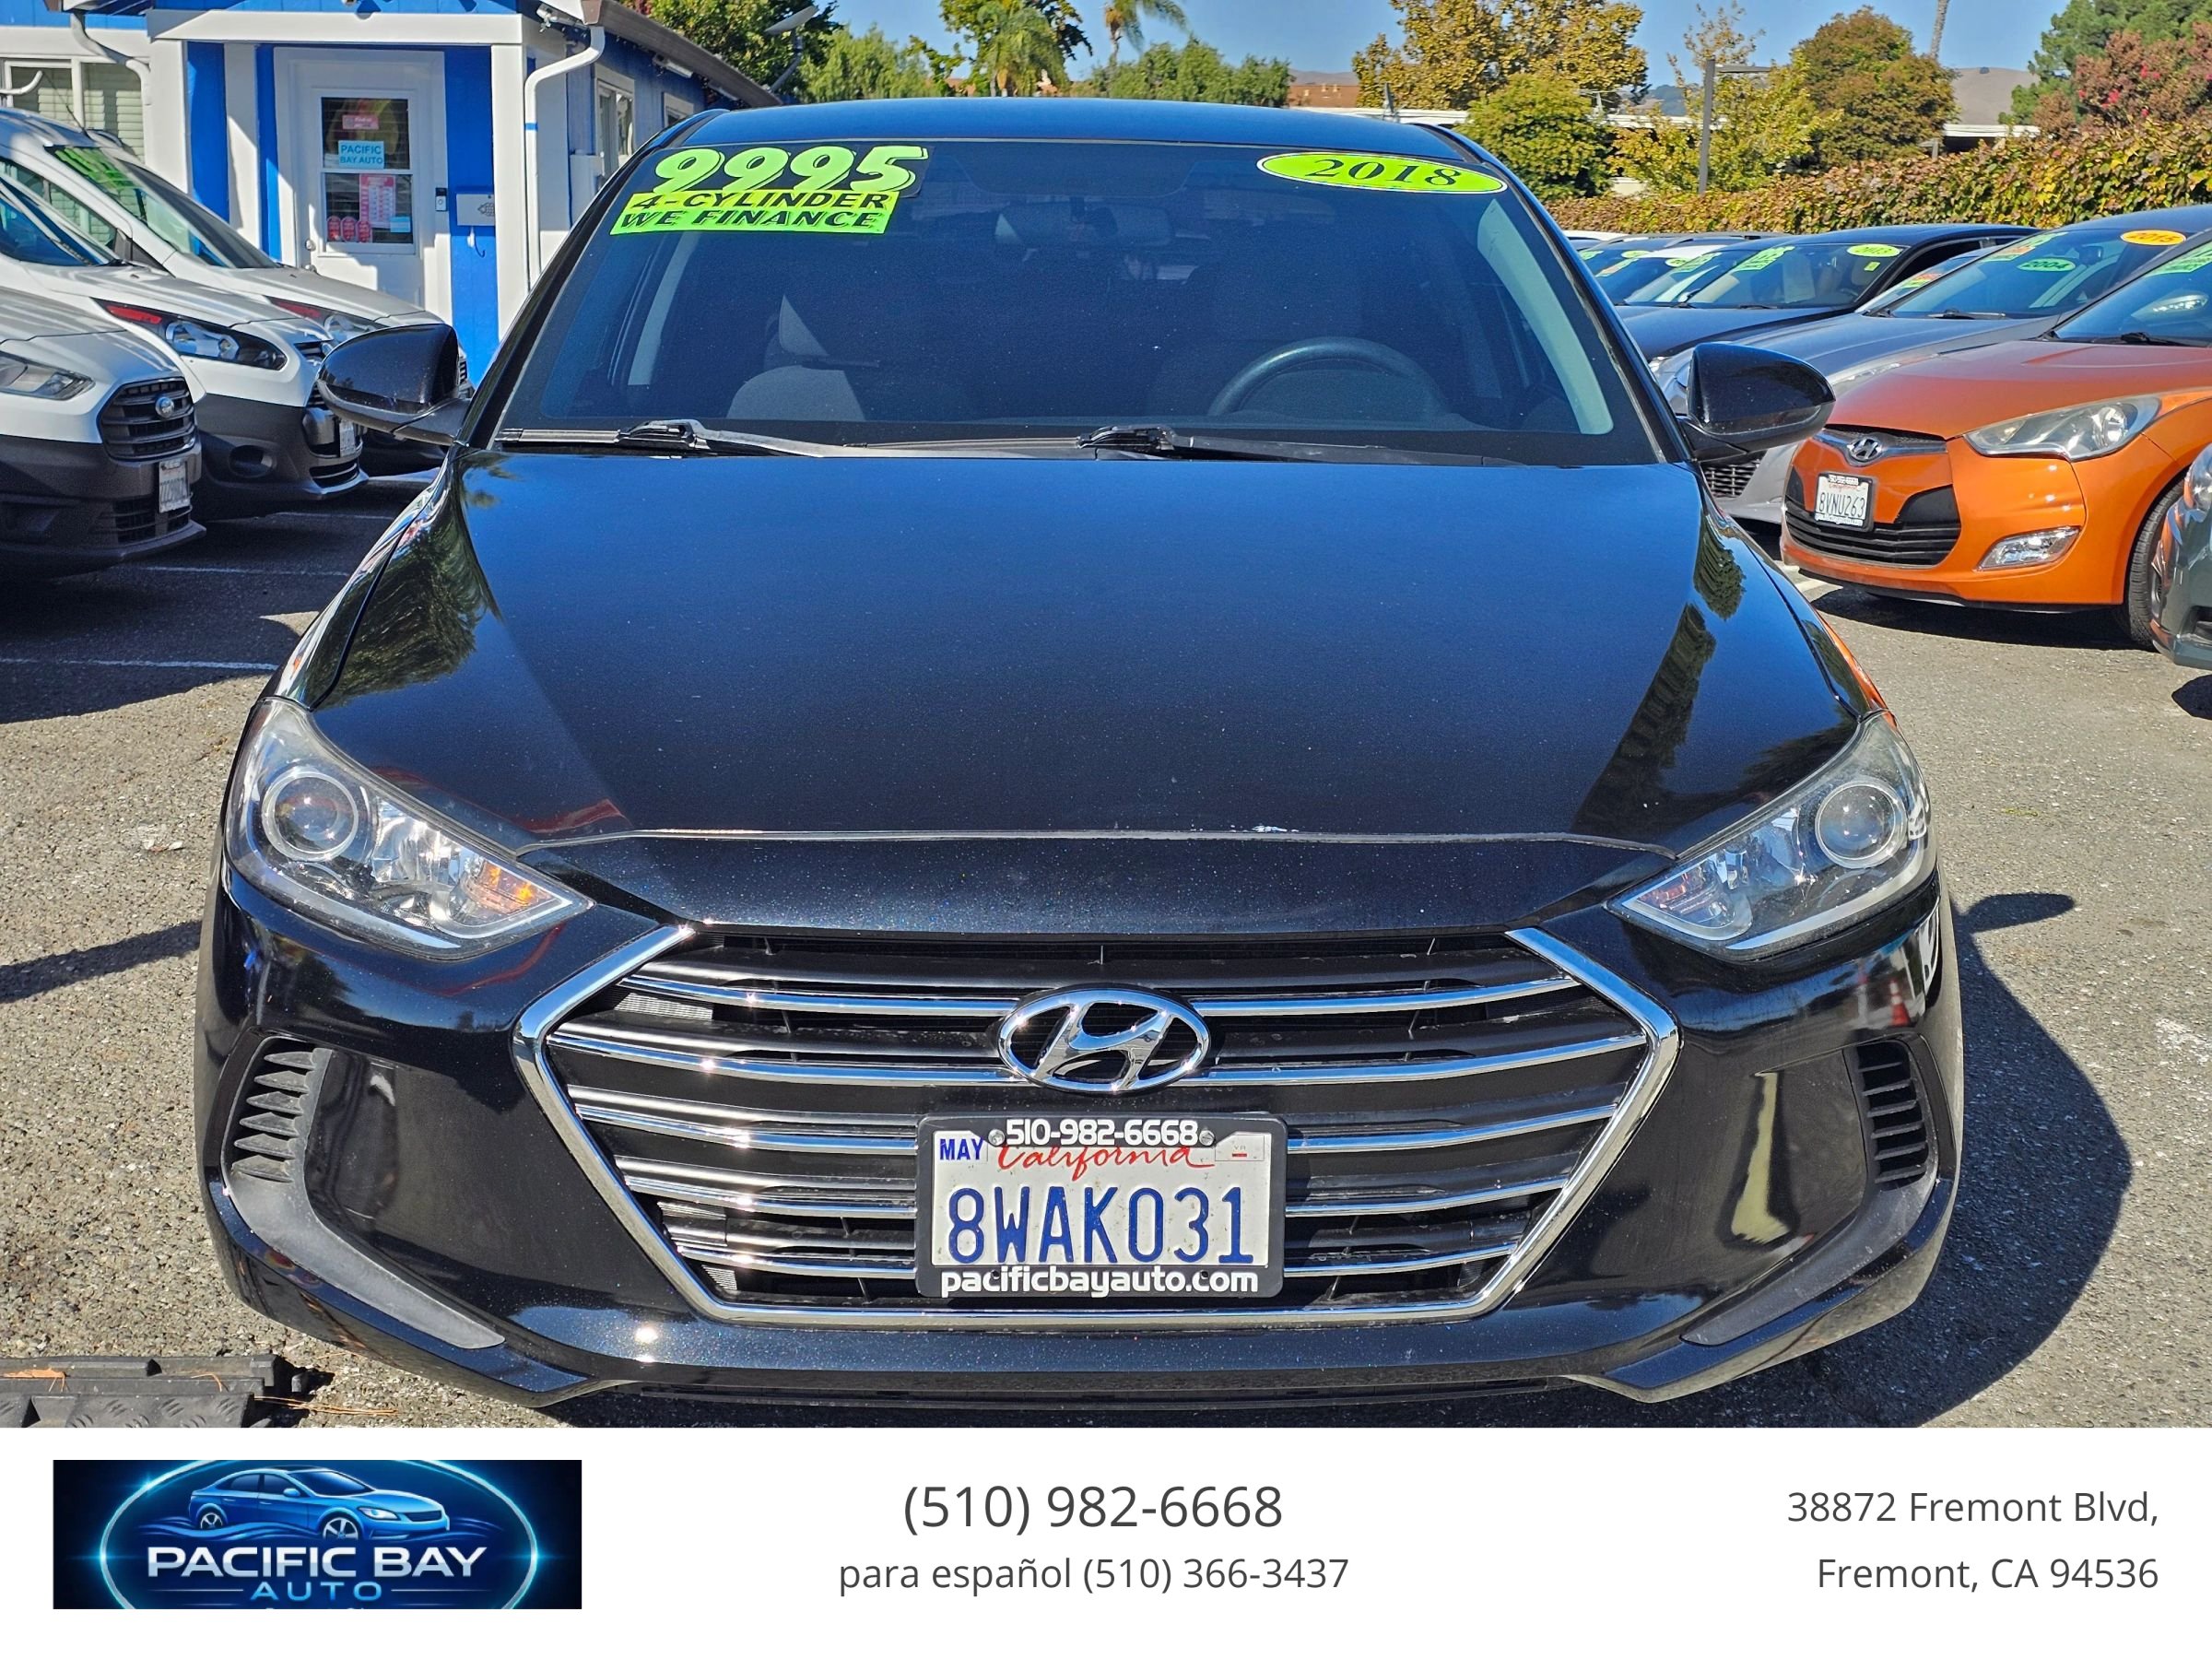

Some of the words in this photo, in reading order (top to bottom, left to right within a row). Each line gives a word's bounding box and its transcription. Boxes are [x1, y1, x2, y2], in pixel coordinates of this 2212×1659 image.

[341, 145, 381, 155] PACIFIC
[653, 146, 928, 192] 9995
[1305, 159, 1461, 185] 2018
[631, 192, 894, 210] 4-CYLINDER
[619, 210, 687, 229] WE
[691, 209, 883, 229] FINANCE
[2022, 261, 2070, 269] 2004
[1819, 492, 1865, 517] 8VNU263
[1006, 1118, 1199, 1147] 510-982-6668
[938, 1137, 984, 1161] MAY
[996, 1145, 1216, 1182] California
[947, 1185, 1254, 1265] 8WAK031
[940, 1265, 1259, 1298] pacificbayauto.com
